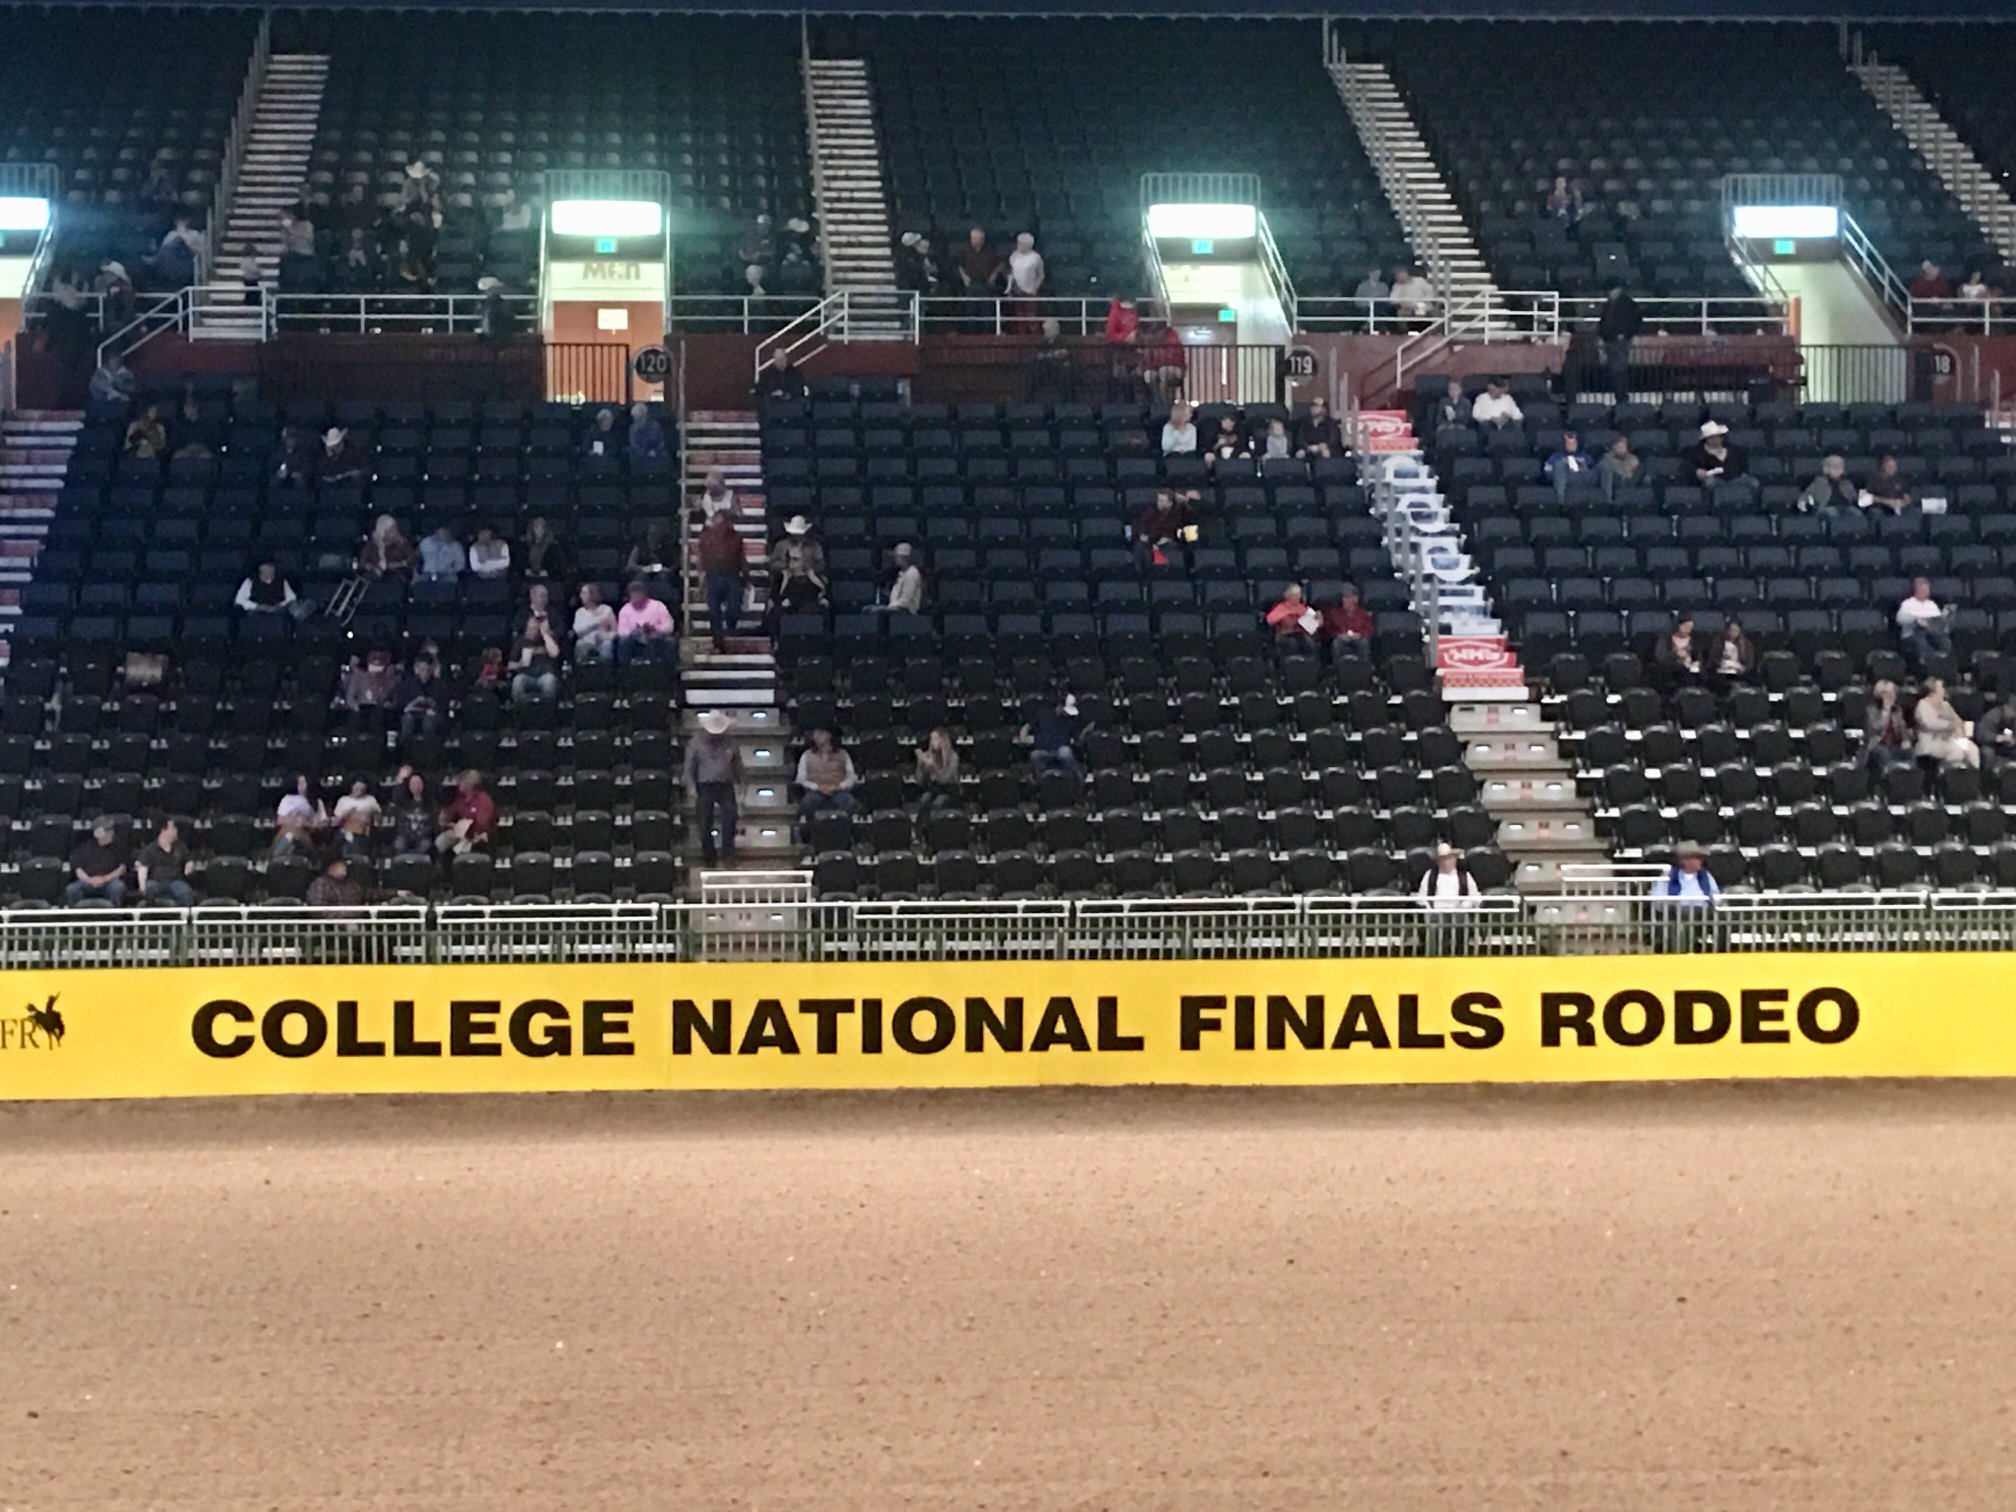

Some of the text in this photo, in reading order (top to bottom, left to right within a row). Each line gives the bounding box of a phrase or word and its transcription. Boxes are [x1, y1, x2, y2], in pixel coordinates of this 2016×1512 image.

[640, 353, 667, 373] 120
[1289, 355, 1313, 375] 119
[191, 987, 1860, 1059] COLLEGE NATIONAL FINALS RODEO
